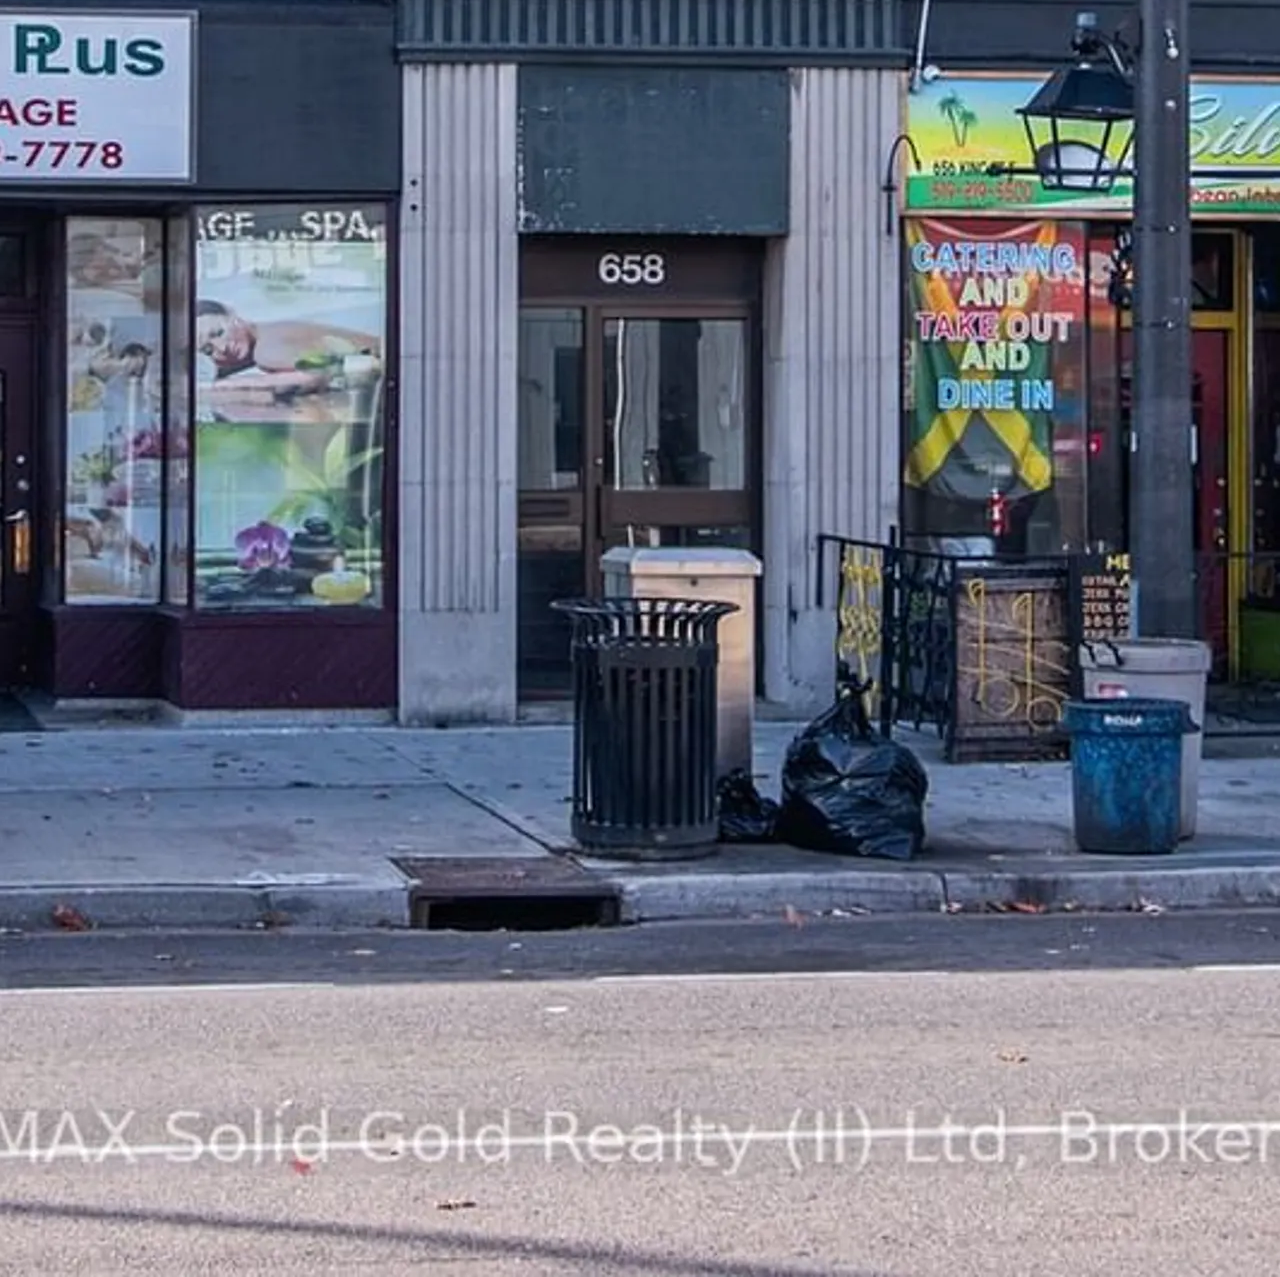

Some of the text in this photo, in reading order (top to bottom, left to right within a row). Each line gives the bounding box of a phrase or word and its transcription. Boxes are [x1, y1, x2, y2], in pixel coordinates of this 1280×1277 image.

[599, 254, 665, 284] 658
[912, 243, 1076, 273] CATERING
[959, 277, 1030, 307] AND
[917, 311, 1073, 342] TAKE OUT
[961, 342, 1032, 371] AND
[937, 379, 1055, 410] DINE IN
